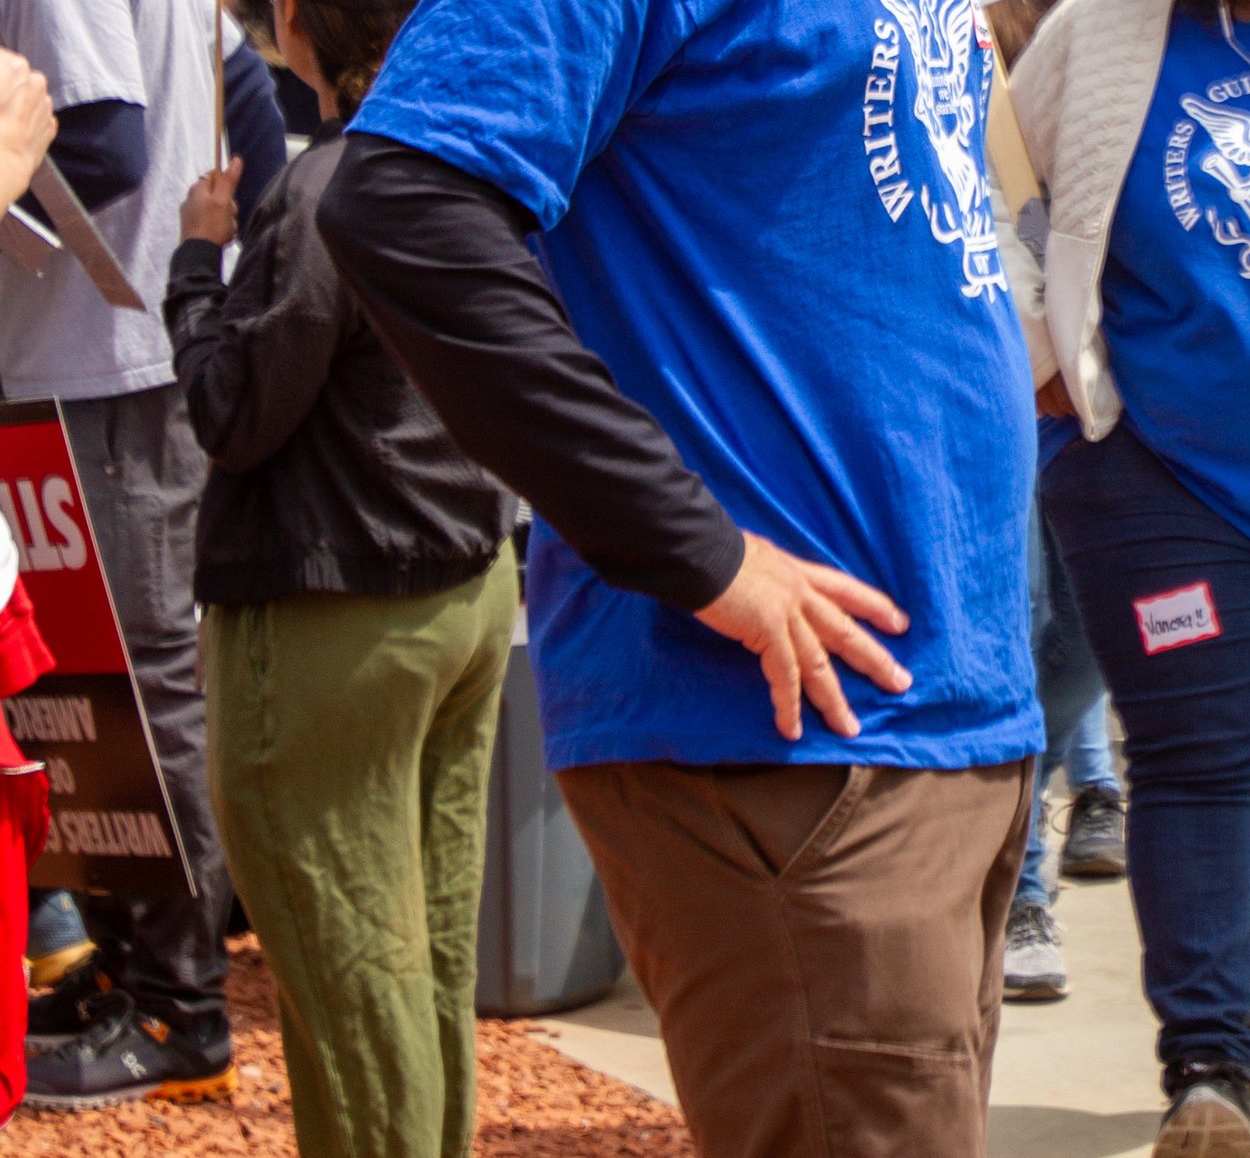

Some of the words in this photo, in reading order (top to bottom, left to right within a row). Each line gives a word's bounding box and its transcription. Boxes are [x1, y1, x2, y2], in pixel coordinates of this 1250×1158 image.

[862, 17, 916, 225] WRITERS
[1164, 121, 1201, 232] WRITERS
[58, 810, 174, 859] WRITERS
